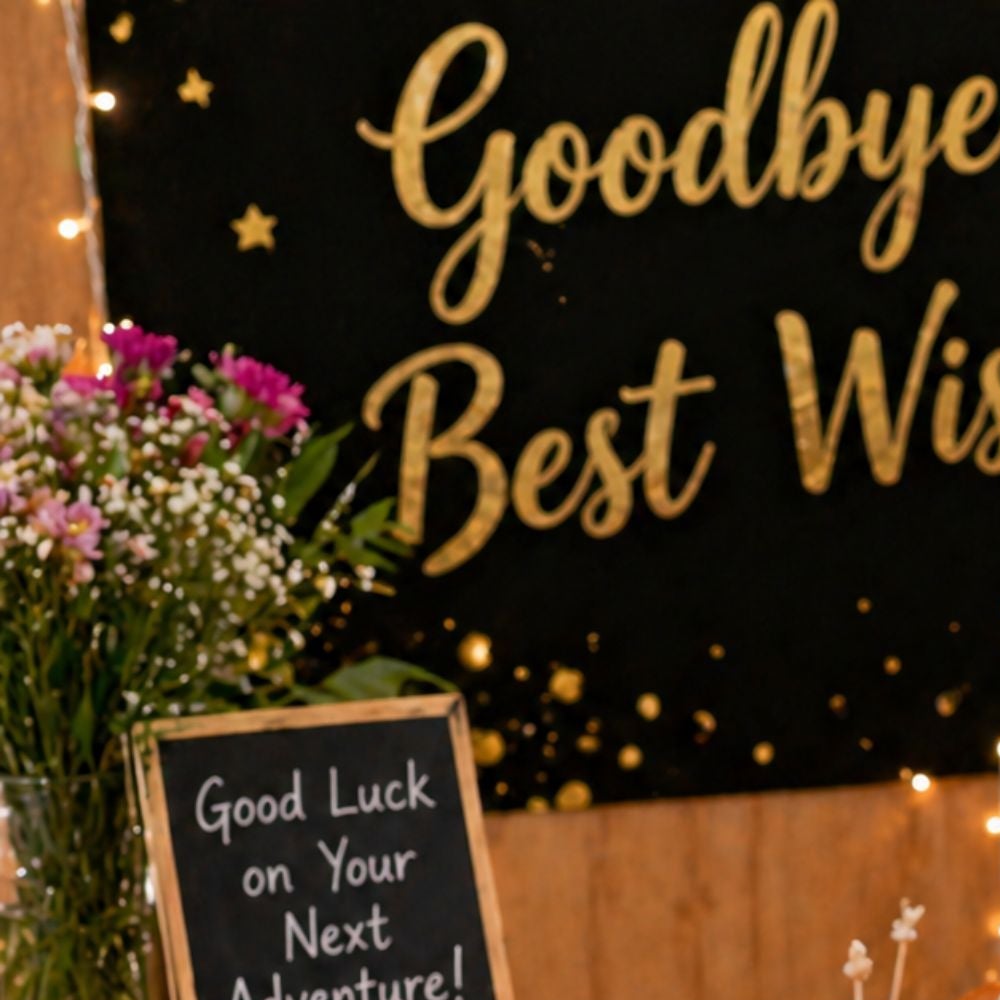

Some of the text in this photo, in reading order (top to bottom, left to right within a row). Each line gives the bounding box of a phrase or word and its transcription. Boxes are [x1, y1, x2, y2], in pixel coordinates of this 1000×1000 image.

[362, 338, 715, 576] Best
[195, 758, 437, 845] Good Luck
[242, 835, 417, 897] on Your
[285, 902, 393, 963] Next
